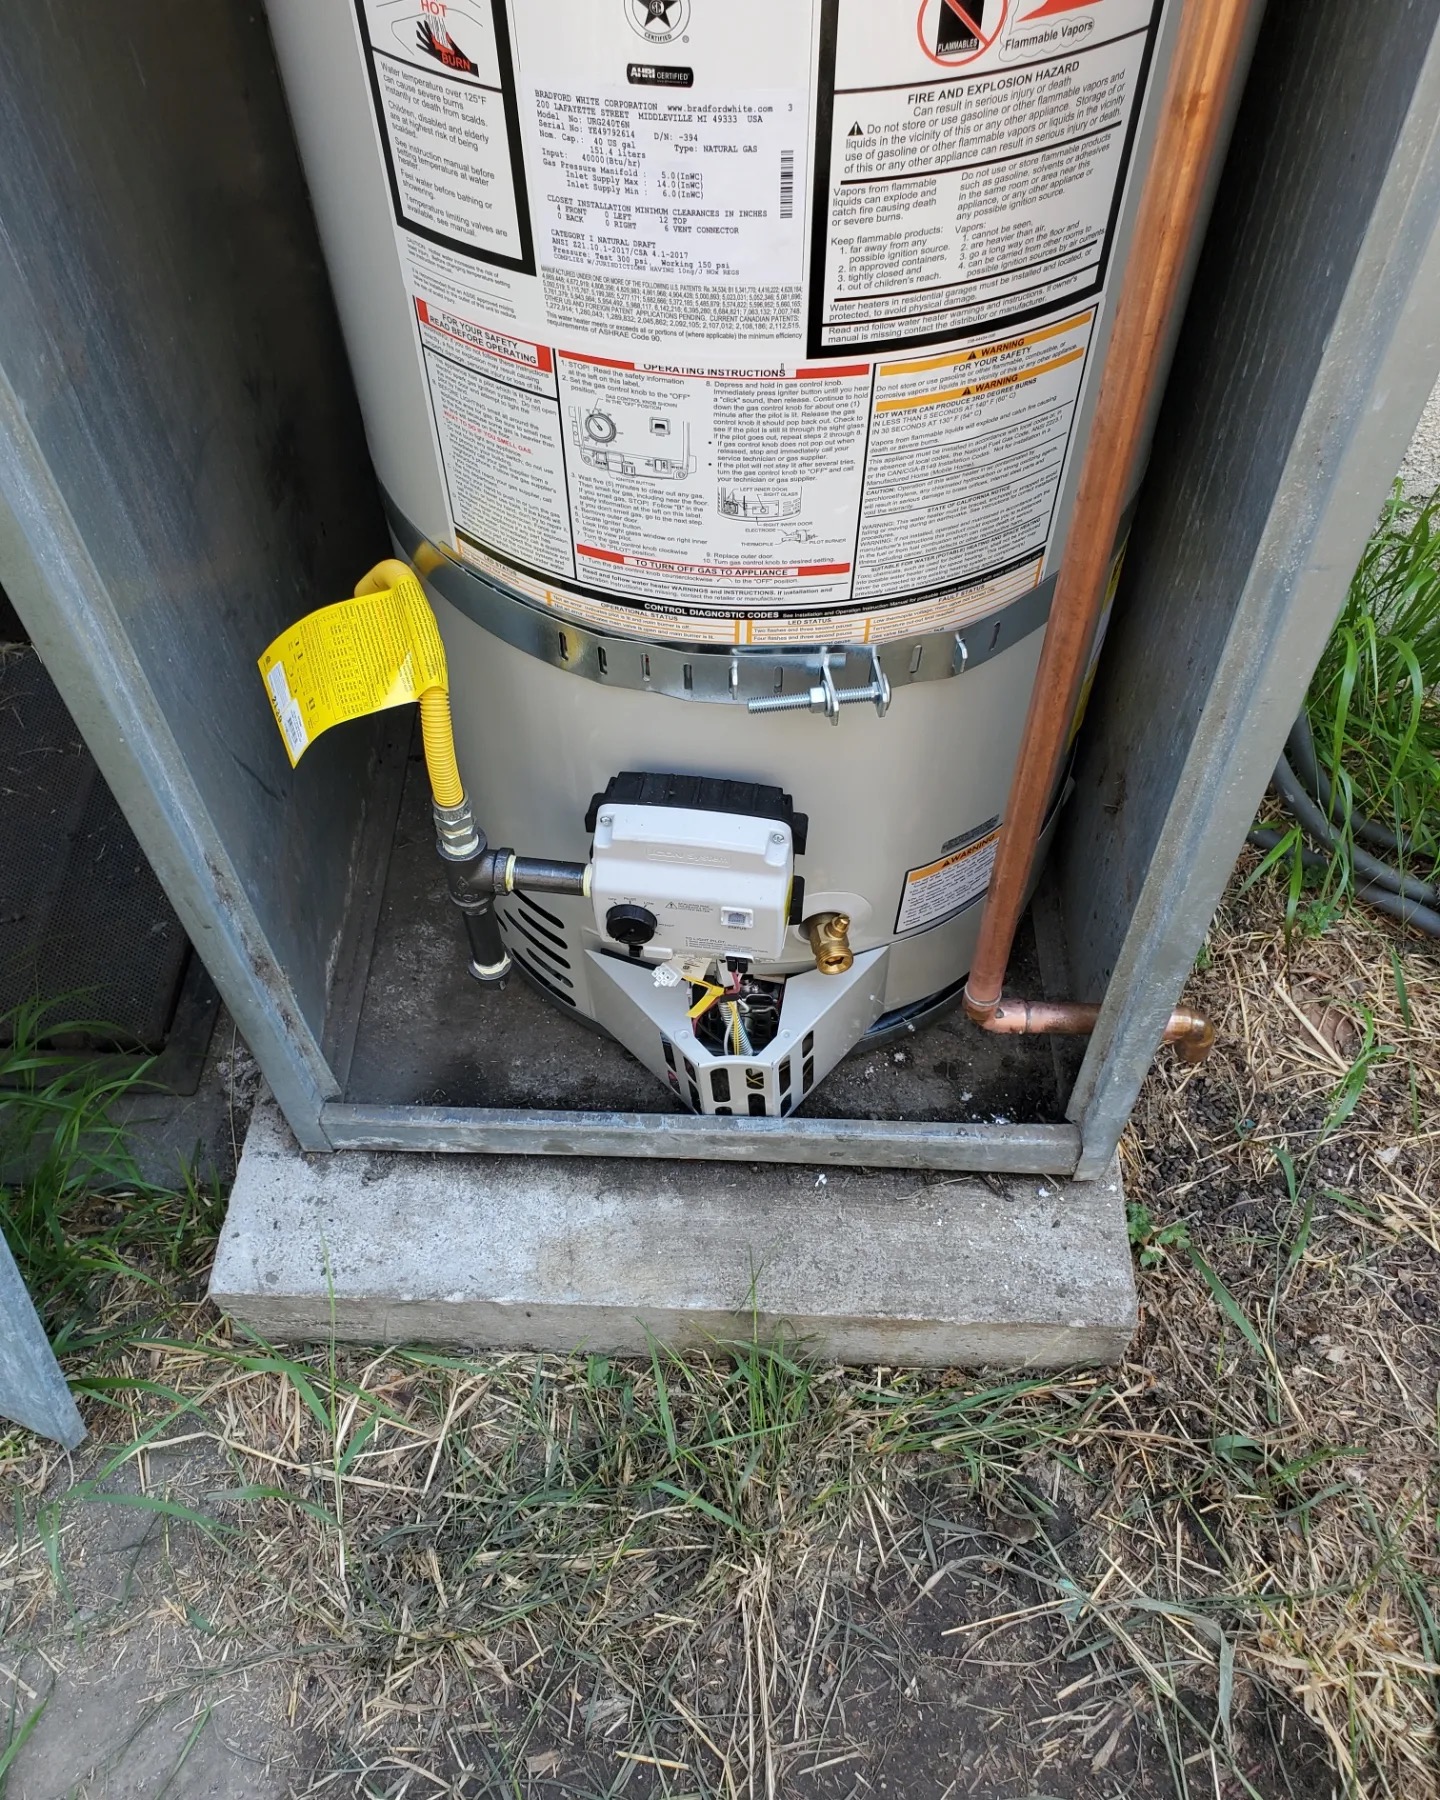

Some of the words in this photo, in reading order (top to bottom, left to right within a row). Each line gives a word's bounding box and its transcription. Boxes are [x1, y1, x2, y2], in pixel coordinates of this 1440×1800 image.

[421, 0, 447, 17] HOT
[645, 32, 672, 41] CERTIFIED
[938, 38, 978, 52] FLAMMABLES
[1005, 31, 1058, 50] Flammable
[1061, 20, 1094, 37] Vapors
[442, 53, 470, 70] BURN
[381, 62, 400, 76] Water
[402, 71, 443, 92] temperature
[445, 88, 461, 98] over
[464, 92, 487, 105] 125°F
[631, 67, 655, 78] AHRI
[657, 72, 688, 80] CERTIFIED
[907, 92, 935, 105] FIRE
[938, 88, 963, 100] AND
[967, 73, 1032, 95] EXPLOSION
[1035, 61, 1080, 81] HAZARD
[383, 74, 395, 84] can
[396, 80, 415, 93] cause
[418, 89, 441, 102] severe
[443, 96, 463, 110] burns
[535, 90, 572, 102] BRADFORD
[576, 96, 600, 106] WHITE
[605, 99, 658, 110] CORPORATION
[667, 104, 773, 113] www.bradfordwhite.com
[788, 103, 793, 112] 3
[867, 124, 881, 134] Do
[884, 122, 899, 133] not
[902, 119, 926, 131] store
[931, 118, 939, 127] or
[941, 115, 957, 126] use
[960, 106, 998, 124] gasoline
[1001, 104, 1011, 112] or
[1013, 98, 1036, 111] other
[1038, 85, 1080, 104] flammable
[1082, 76, 1109, 93] vapors
[1109, 69, 1125, 83] and
[913, 106, 933, 117] Can
[935, 100, 962, 113] result
[964, 99, 972, 109] in
[975, 94, 1008, 108] serious
[1010, 88, 1035, 101] injury
[1036, 85, 1046, 94] or
[1048, 76, 1072, 91] death
[385, 85, 411, 103] instantly
[422, 100, 441, 113] death
[443, 106, 459, 119] from
[461, 113, 488, 127] scalds.
[536, 100, 550, 109] 200
[554, 103, 596, 116] LAFAYETTE
[601, 109, 629, 119] STREET
[638, 113, 693, 123] MIDDLEVILLE
[697, 115, 707, 123] MI
[713, 115, 738, 123] 49333
[747, 115, 763, 123] USA
[537, 110, 560, 120] Model
[568, 115, 582, 123] No:
[587, 117, 630, 128] URG240T6N
[539, 119, 565, 131] Serial
[569, 125, 583, 133] No:
[654, 132, 673, 141] D/N:
[679, 134, 698, 142] -394
[540, 130, 556, 139] Nom.
[561, 133, 584, 143] Cap.:
[594, 137, 603, 145] 40
[607, 139, 617, 147] US
[622, 141, 636, 149] gal
[674, 144, 698, 154] Type:
[590, 146, 613, 155] 151.4
[618, 148, 646, 158] liters
[542, 148, 568, 159] Input:
[582, 154, 641, 168] 40000(Btu/hr)
[543, 158, 556, 167] Gas
[560, 160, 596, 172] Pressure
[600, 167, 638, 177] Manifold
[661, 171, 703, 181] 5.0(InWC)
[566, 170, 588, 180] Inlet
[592, 173, 620, 185] Supply
[657, 180, 703, 190] 14.0(InWC)
[567, 180, 589, 190] Inlet
[593, 183, 621, 195] Supply
[624, 187, 639, 195] Min
[662, 190, 704, 199] 6.0(InWC)
[547, 194, 573, 205] CLOSET
[577, 199, 631, 212] INSTALLATION
[635, 206, 669, 216] MINIMUM
[673, 209, 720, 217] CLEARANCES
[739, 210, 768, 218] INCHES
[565, 206, 587, 215] FRONT
[613, 212, 632, 220] LEFT
[659, 216, 668, 224] 12
[566, 214, 584, 222] BACK
[614, 221, 637, 229] RIGHT
[664, 224, 669, 232] 6
[551, 229, 585, 241] CATEGORY
[597, 236, 629, 247] NATURAL
[633, 240, 656, 249] DRAFT
[552, 238, 568, 246] ANSI
[652, 250, 688, 259] 4.1-2017
[553, 246, 590, 257] Pressure:
[595, 253, 612, 261] Test
[617, 255, 630, 263] 300
[661, 260, 693, 269] Working
[716, 262, 730, 270] psi
[430, 316, 450, 330] READ
[452, 327, 484, 346] BEFORE
[486, 341, 537, 364] OPERATING
[442, 313, 458, 326] FOR
[460, 321, 483, 336] YOUR
[485, 331, 518, 349] SAFETY
[981, 338, 1025, 357] WARNING
[953, 364, 972, 372] FOR
[974, 356, 998, 368] YOUR
[1000, 346, 1032, 361] SAFETY
[643, 363, 705, 376] OPERATING
[707, 368, 786, 377] INSTRUCTIONS
[975, 374, 1018, 392] WARNING
[650, 562, 675, 571] TURN
[677, 565, 695, 573] OFF
[601, 602, 648, 617] OPERATIONAL
[651, 613, 678, 621] STATUS
[644, 603, 687, 615] CONTROL
[689, 609, 745, 618] DIAGNOSTIC
[951, 833, 995, 862] WARNING
